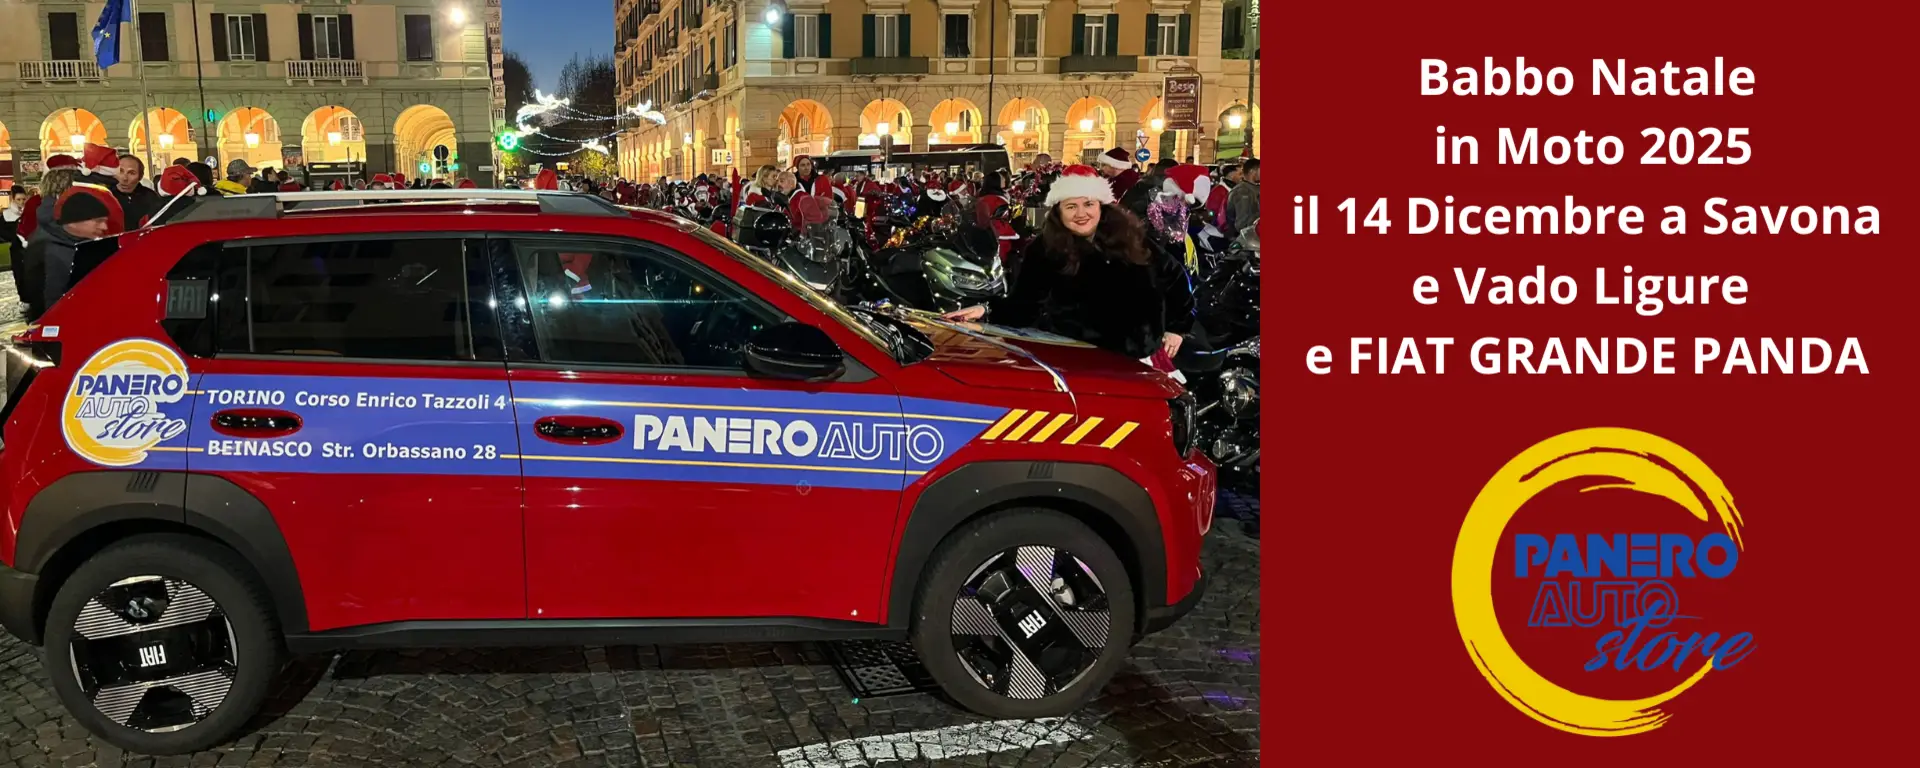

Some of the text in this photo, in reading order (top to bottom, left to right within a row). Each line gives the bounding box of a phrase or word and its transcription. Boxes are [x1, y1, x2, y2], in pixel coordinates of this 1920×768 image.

[168, 285, 206, 314] FIAT
[76, 374, 183, 396] PANERO
[75, 396, 149, 419] AUTO
[207, 390, 506, 410] TORINO Corso Enrico Tazzoli 4
[96, 405, 183, 440] store
[208, 440, 497, 460] BEINASCO Str. Orbassano 28
[1017, 609, 1047, 639] FIAT
[139, 644, 167, 668] FIAT
